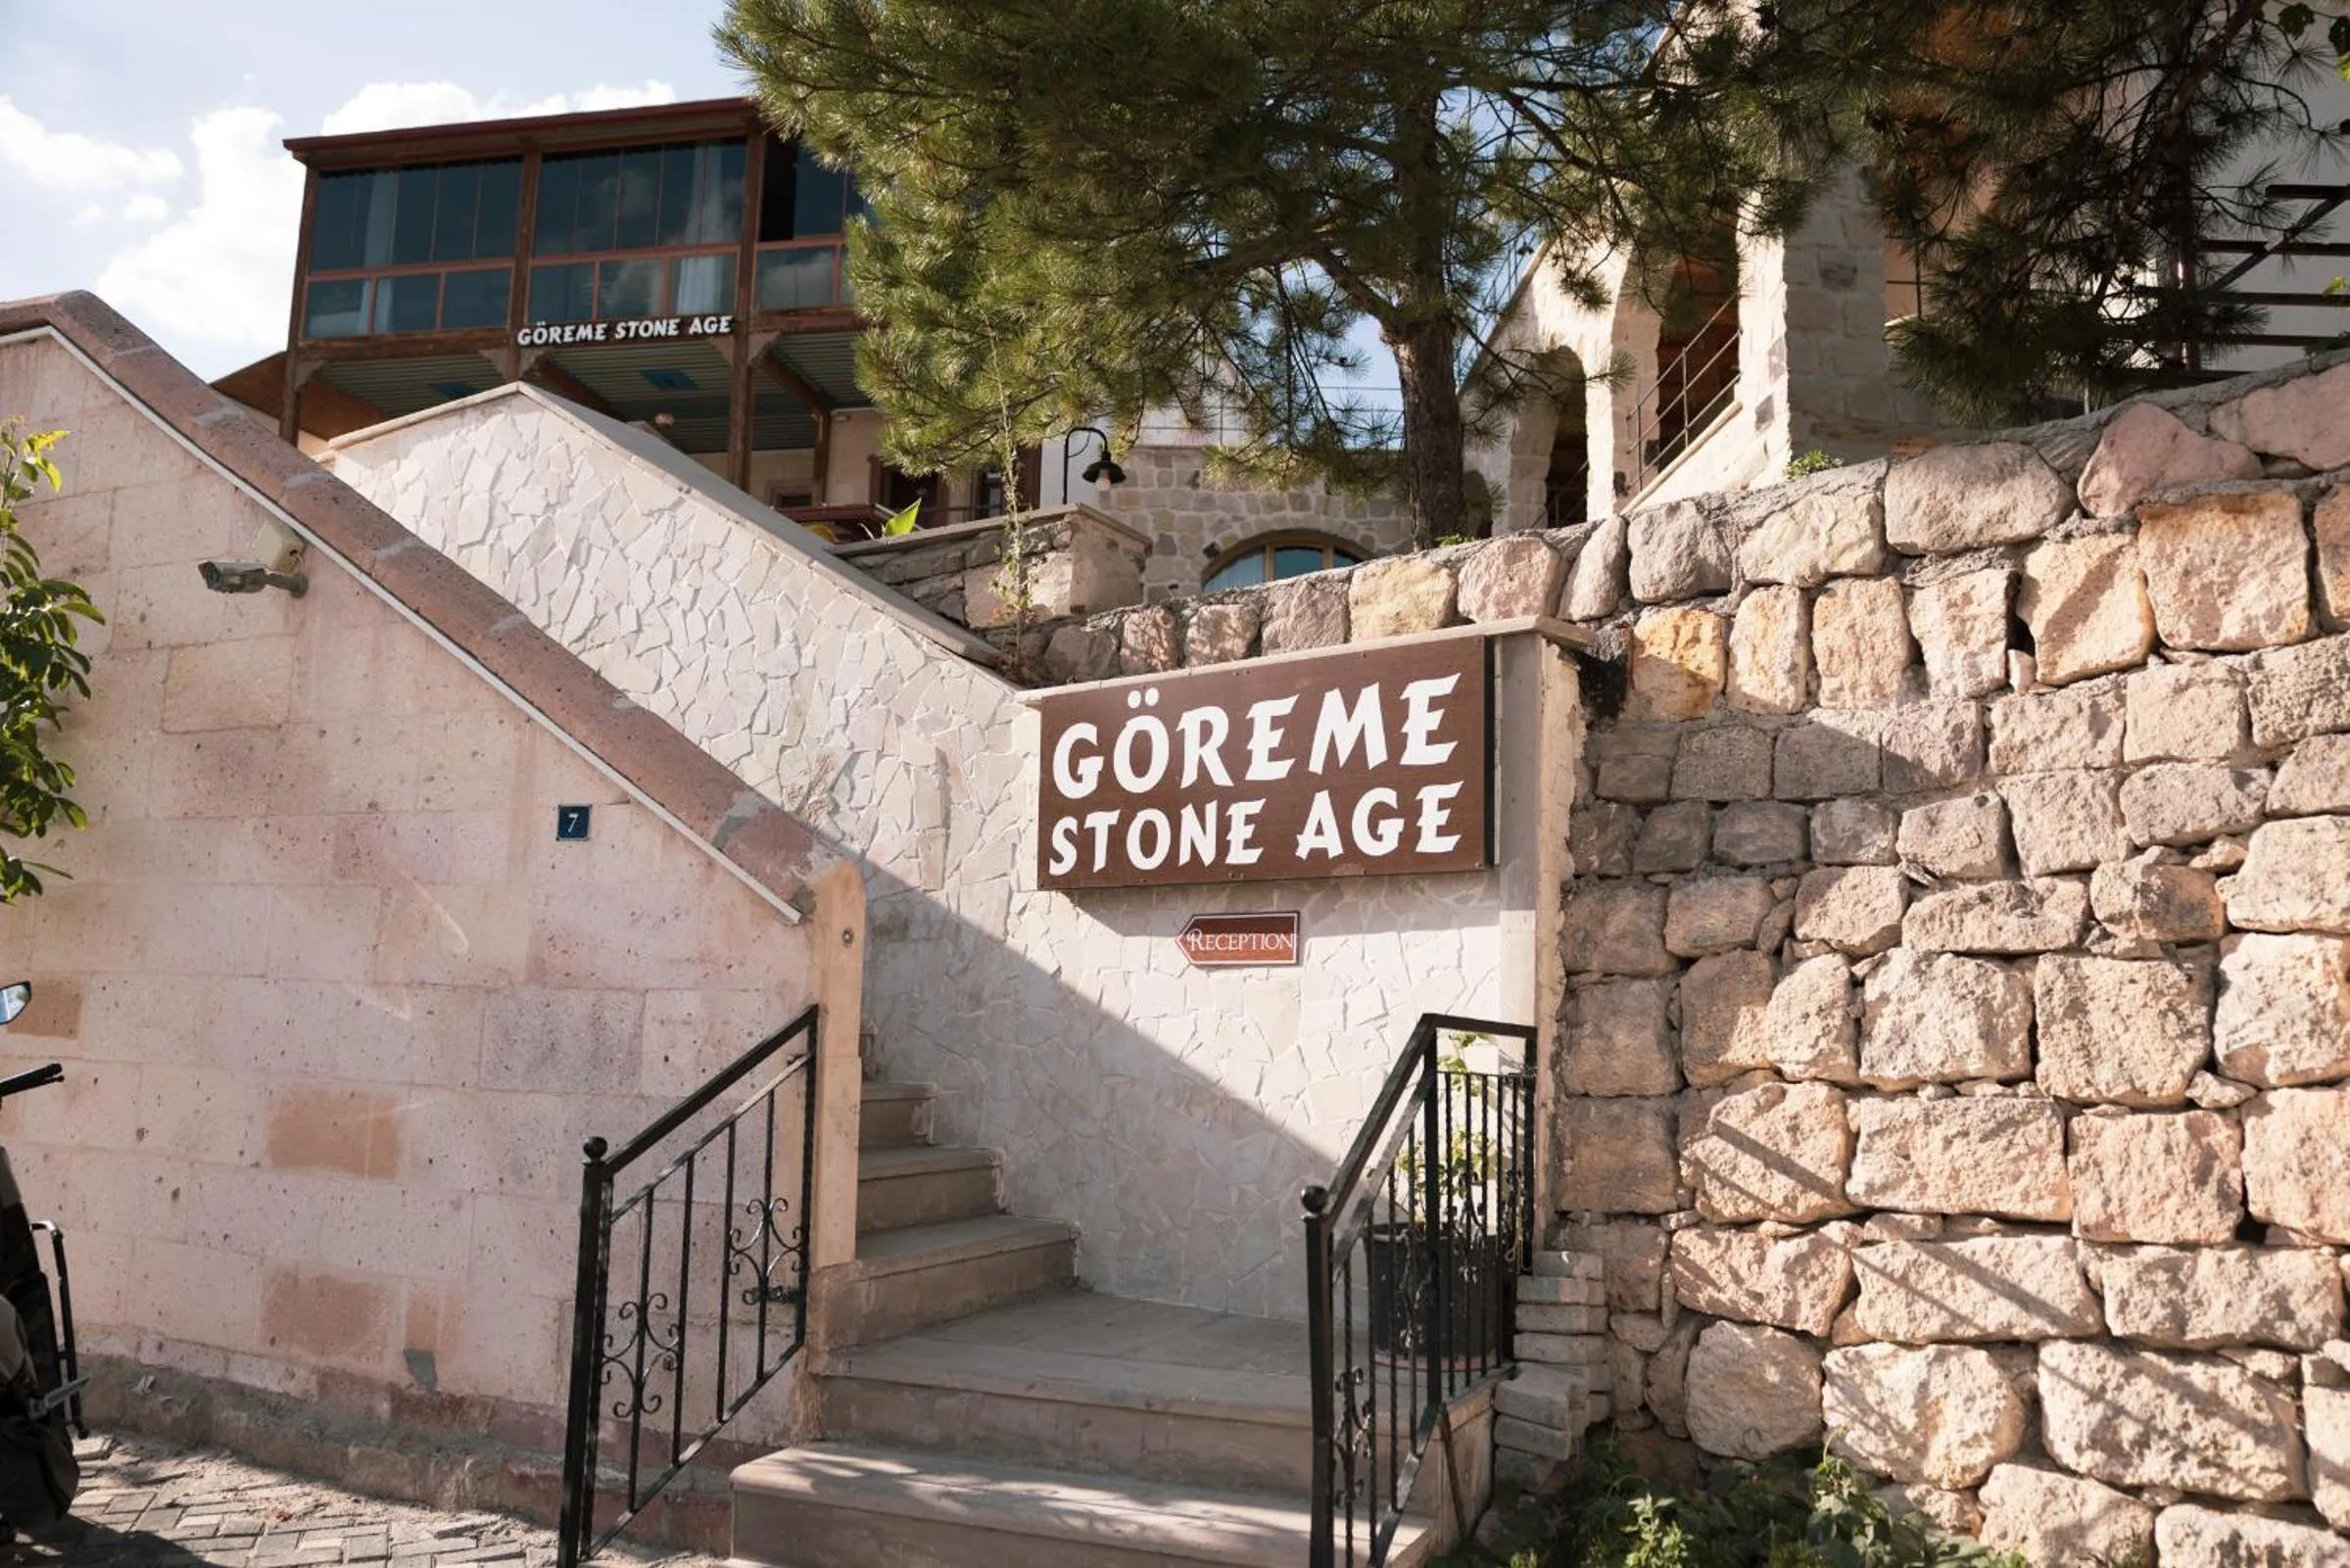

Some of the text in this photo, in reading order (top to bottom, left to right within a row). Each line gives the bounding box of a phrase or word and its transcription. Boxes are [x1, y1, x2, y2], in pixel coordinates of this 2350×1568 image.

[517, 314, 734, 346] GÖREME STONE AGE
[1052, 673, 1462, 800] GÖREME
[568, 813, 579, 832] 7
[1049, 781, 1463, 877] STONE AGE
[1186, 927, 1294, 952] RECEPTION
